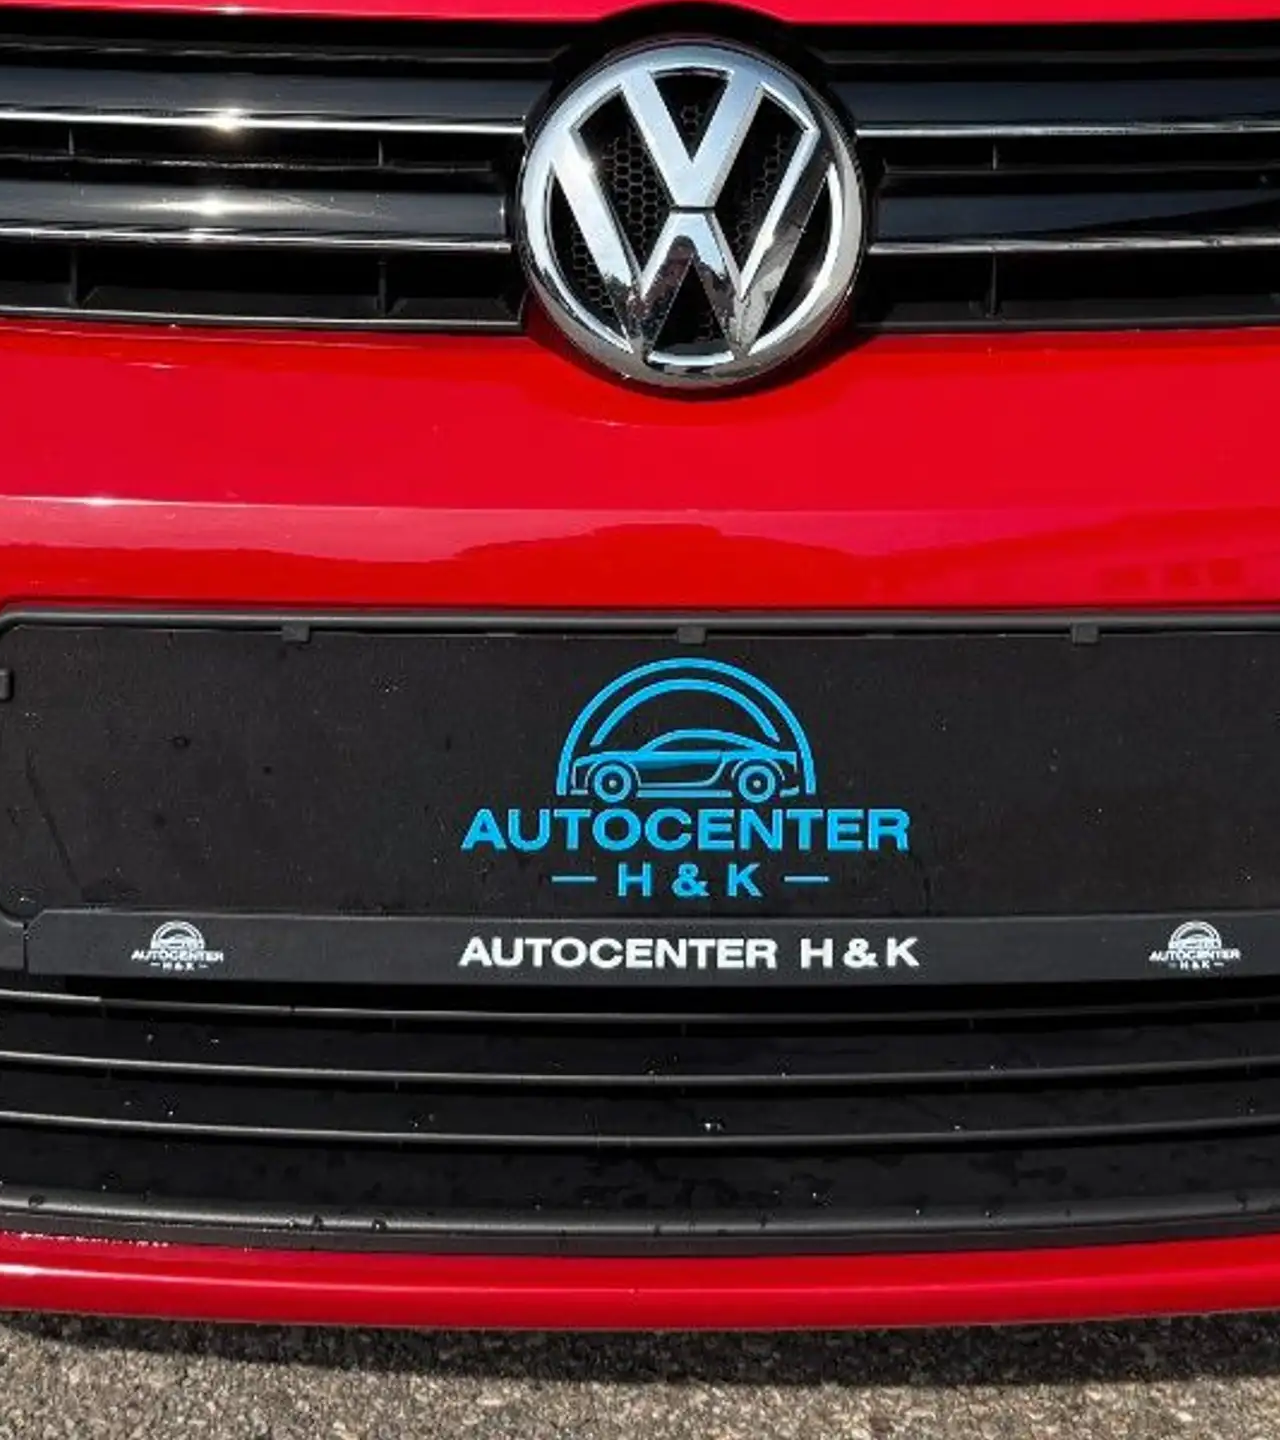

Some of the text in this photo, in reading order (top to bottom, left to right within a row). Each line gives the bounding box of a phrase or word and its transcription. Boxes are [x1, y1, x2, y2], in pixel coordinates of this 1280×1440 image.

[460, 807, 912, 852] AUTOCENTER
[617, 863, 762, 898] H & K
[457, 936, 779, 970] AUTOCENTER
